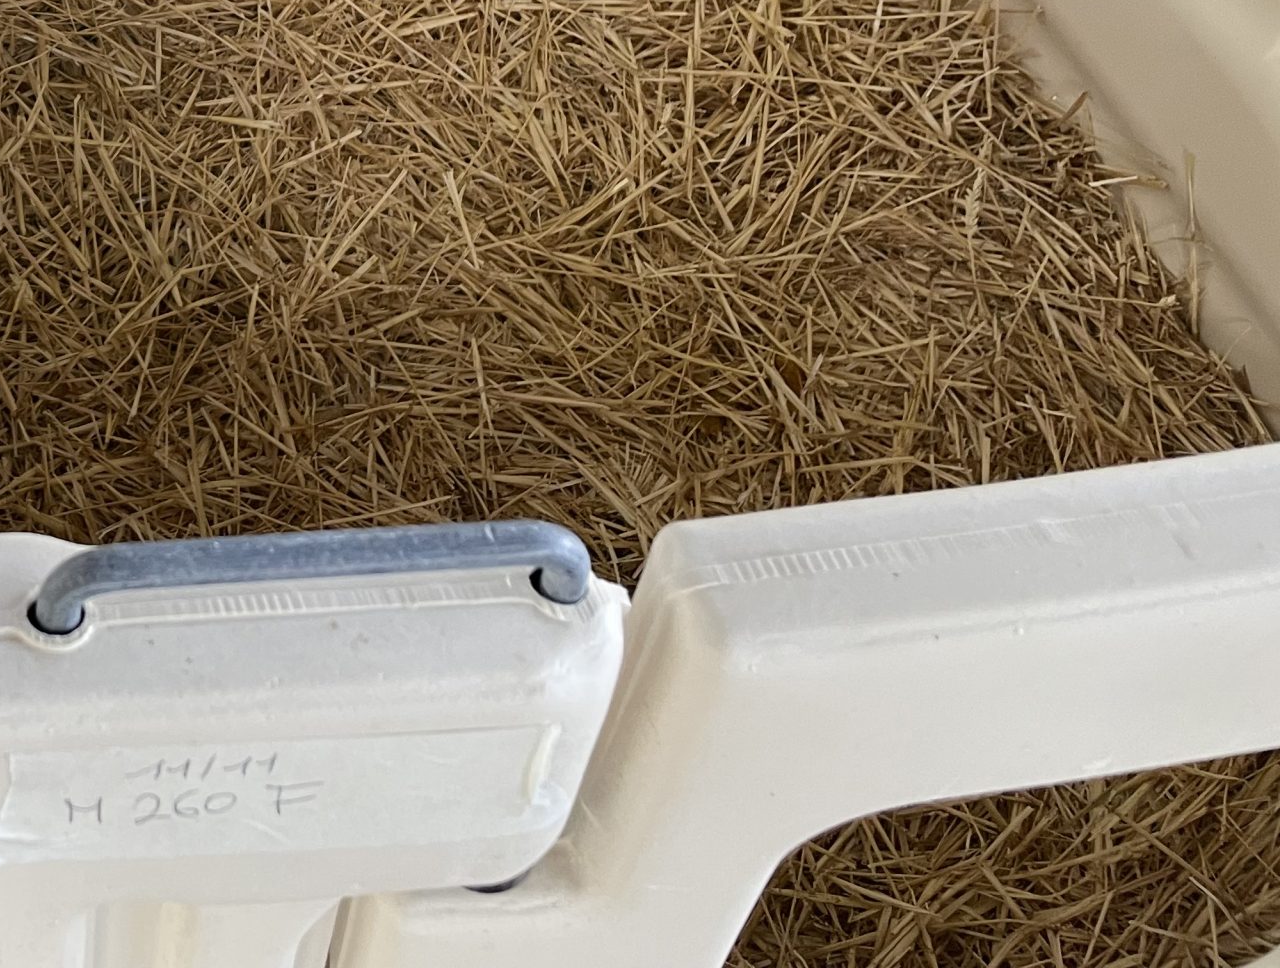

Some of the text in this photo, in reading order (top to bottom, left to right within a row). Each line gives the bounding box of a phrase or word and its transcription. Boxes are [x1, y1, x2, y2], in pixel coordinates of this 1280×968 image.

[124, 752, 278, 781] 11/11
[132, 788, 238, 825] 260
[265, 780, 325, 815] F
